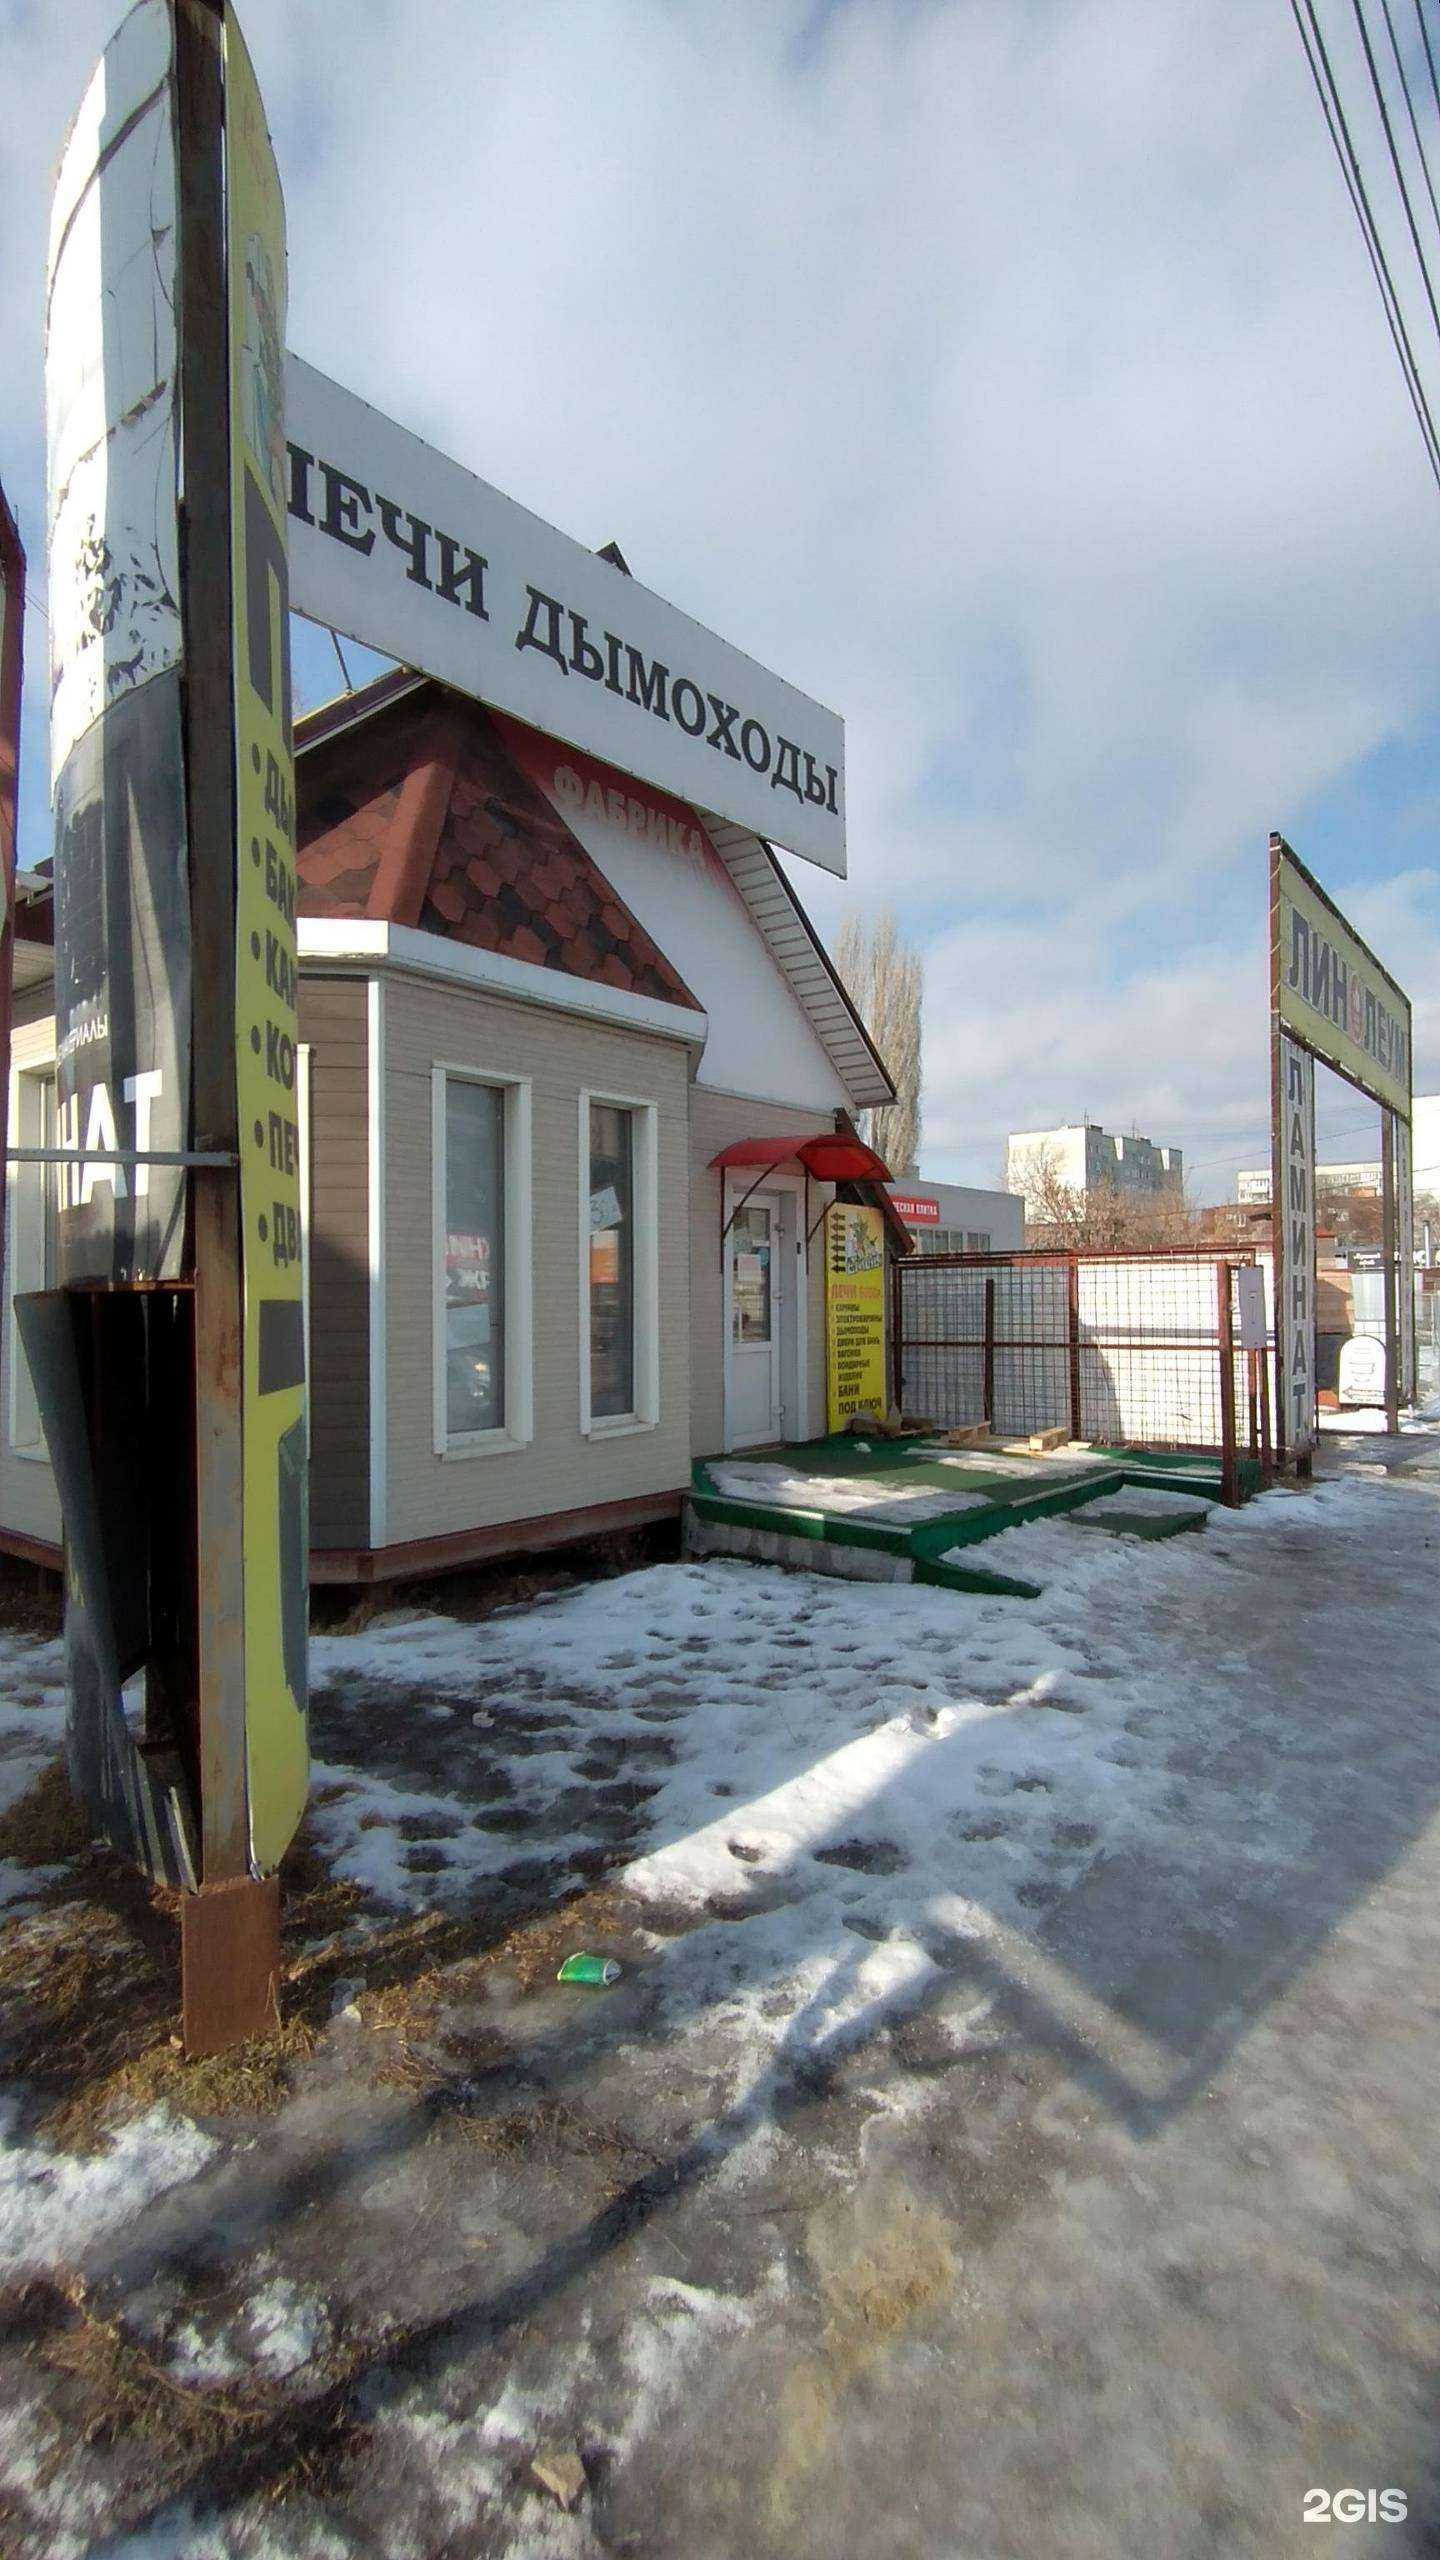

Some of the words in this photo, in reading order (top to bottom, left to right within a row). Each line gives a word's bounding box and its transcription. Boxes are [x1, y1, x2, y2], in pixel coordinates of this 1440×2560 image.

[515, 584, 838, 816] ДЫМОХОДЫ
[553, 764, 710, 875] ФАБРИКА
[1289, 907, 1406, 1085] ЛИНОЛЕУМ
[1289, 1057, 1308, 1424] ЛАМИНАТ
[838, 1384, 860, 1397] БАНИ
[838, 1401, 857, 1415] ПОД
